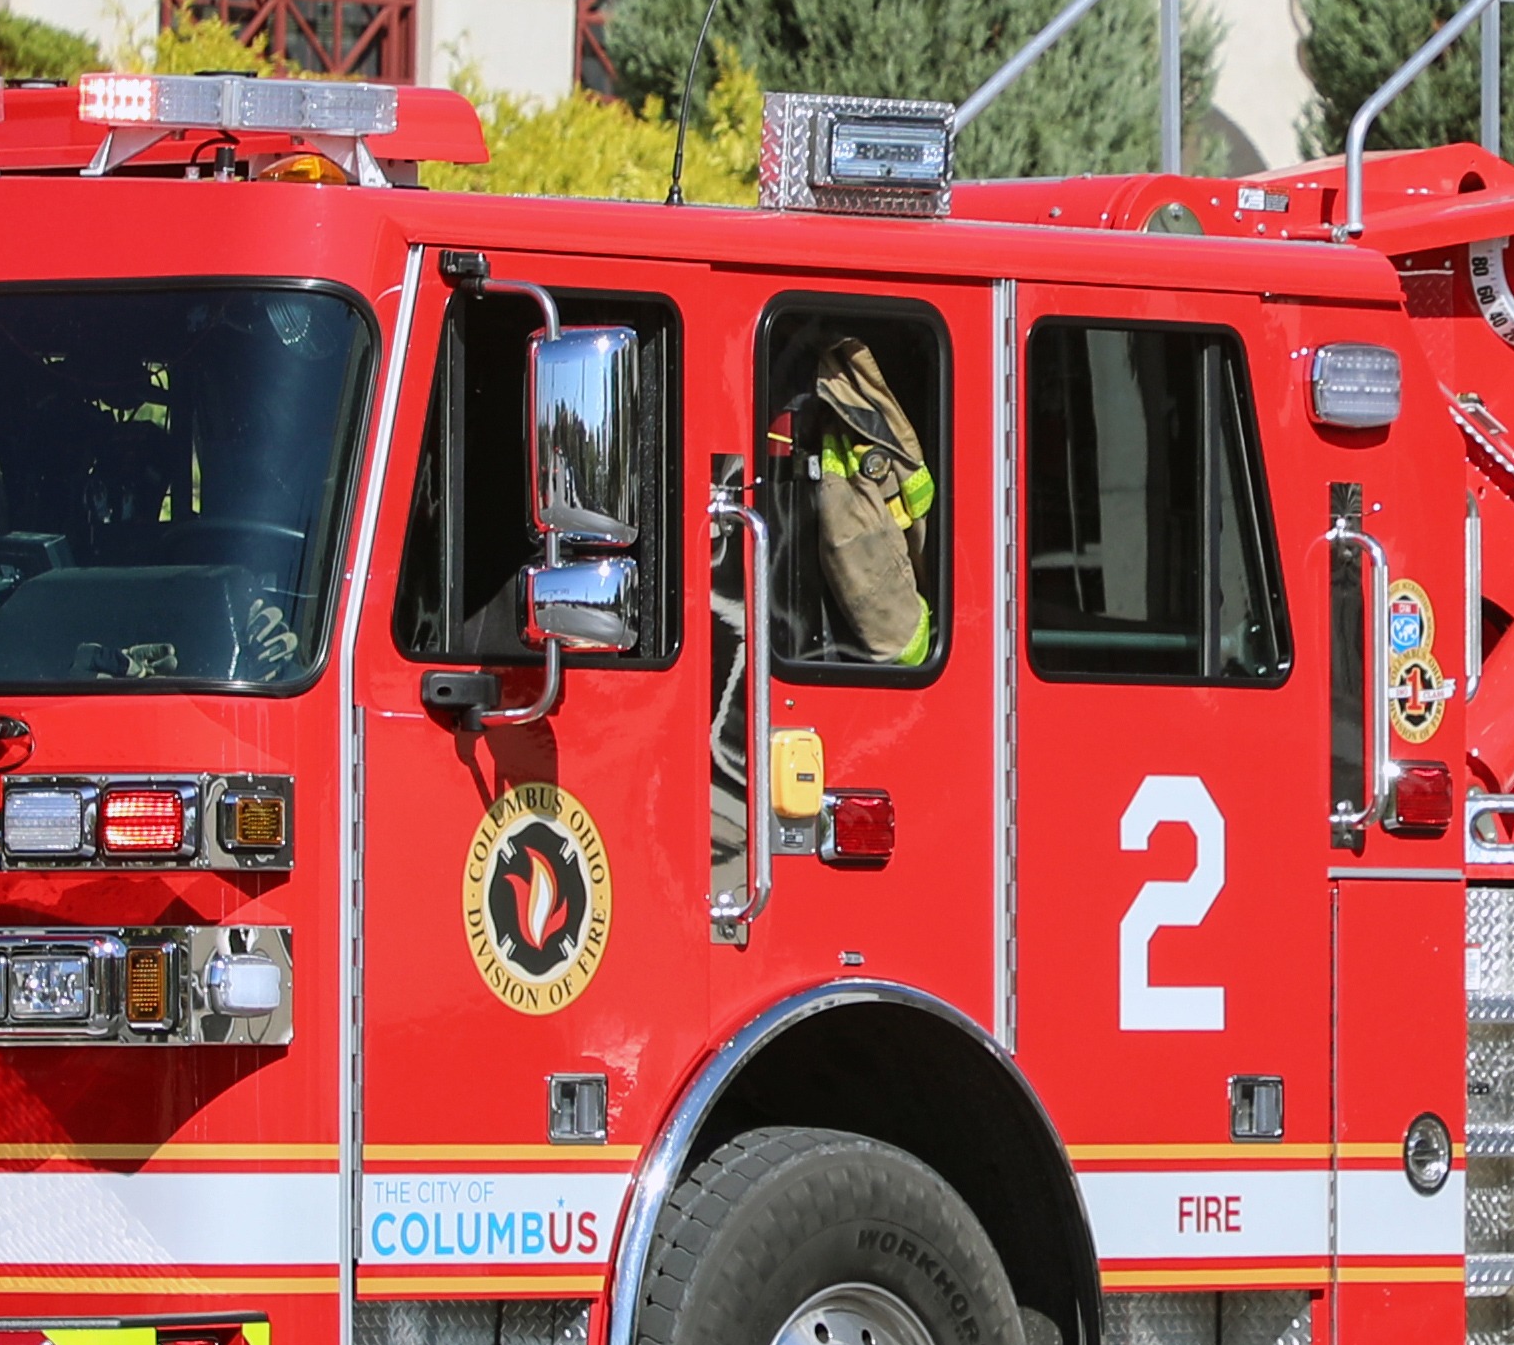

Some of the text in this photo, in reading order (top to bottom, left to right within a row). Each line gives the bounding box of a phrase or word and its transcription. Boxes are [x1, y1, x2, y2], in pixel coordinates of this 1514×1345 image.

[1471, 256, 1489, 277] 80
[1476, 284, 1496, 305] 60
[1489, 311, 1508, 328] 40
[468, 786, 606, 885] COLUMBUS OHIO
[1119, 775, 1226, 1031] 2
[467, 907, 608, 1010] DIVISION OF FIRE
[372, 1180, 495, 1204] THE CITY OF
[1177, 1195, 1243, 1233] FIRE
[371, 1211, 599, 1257] COLUMBUS
